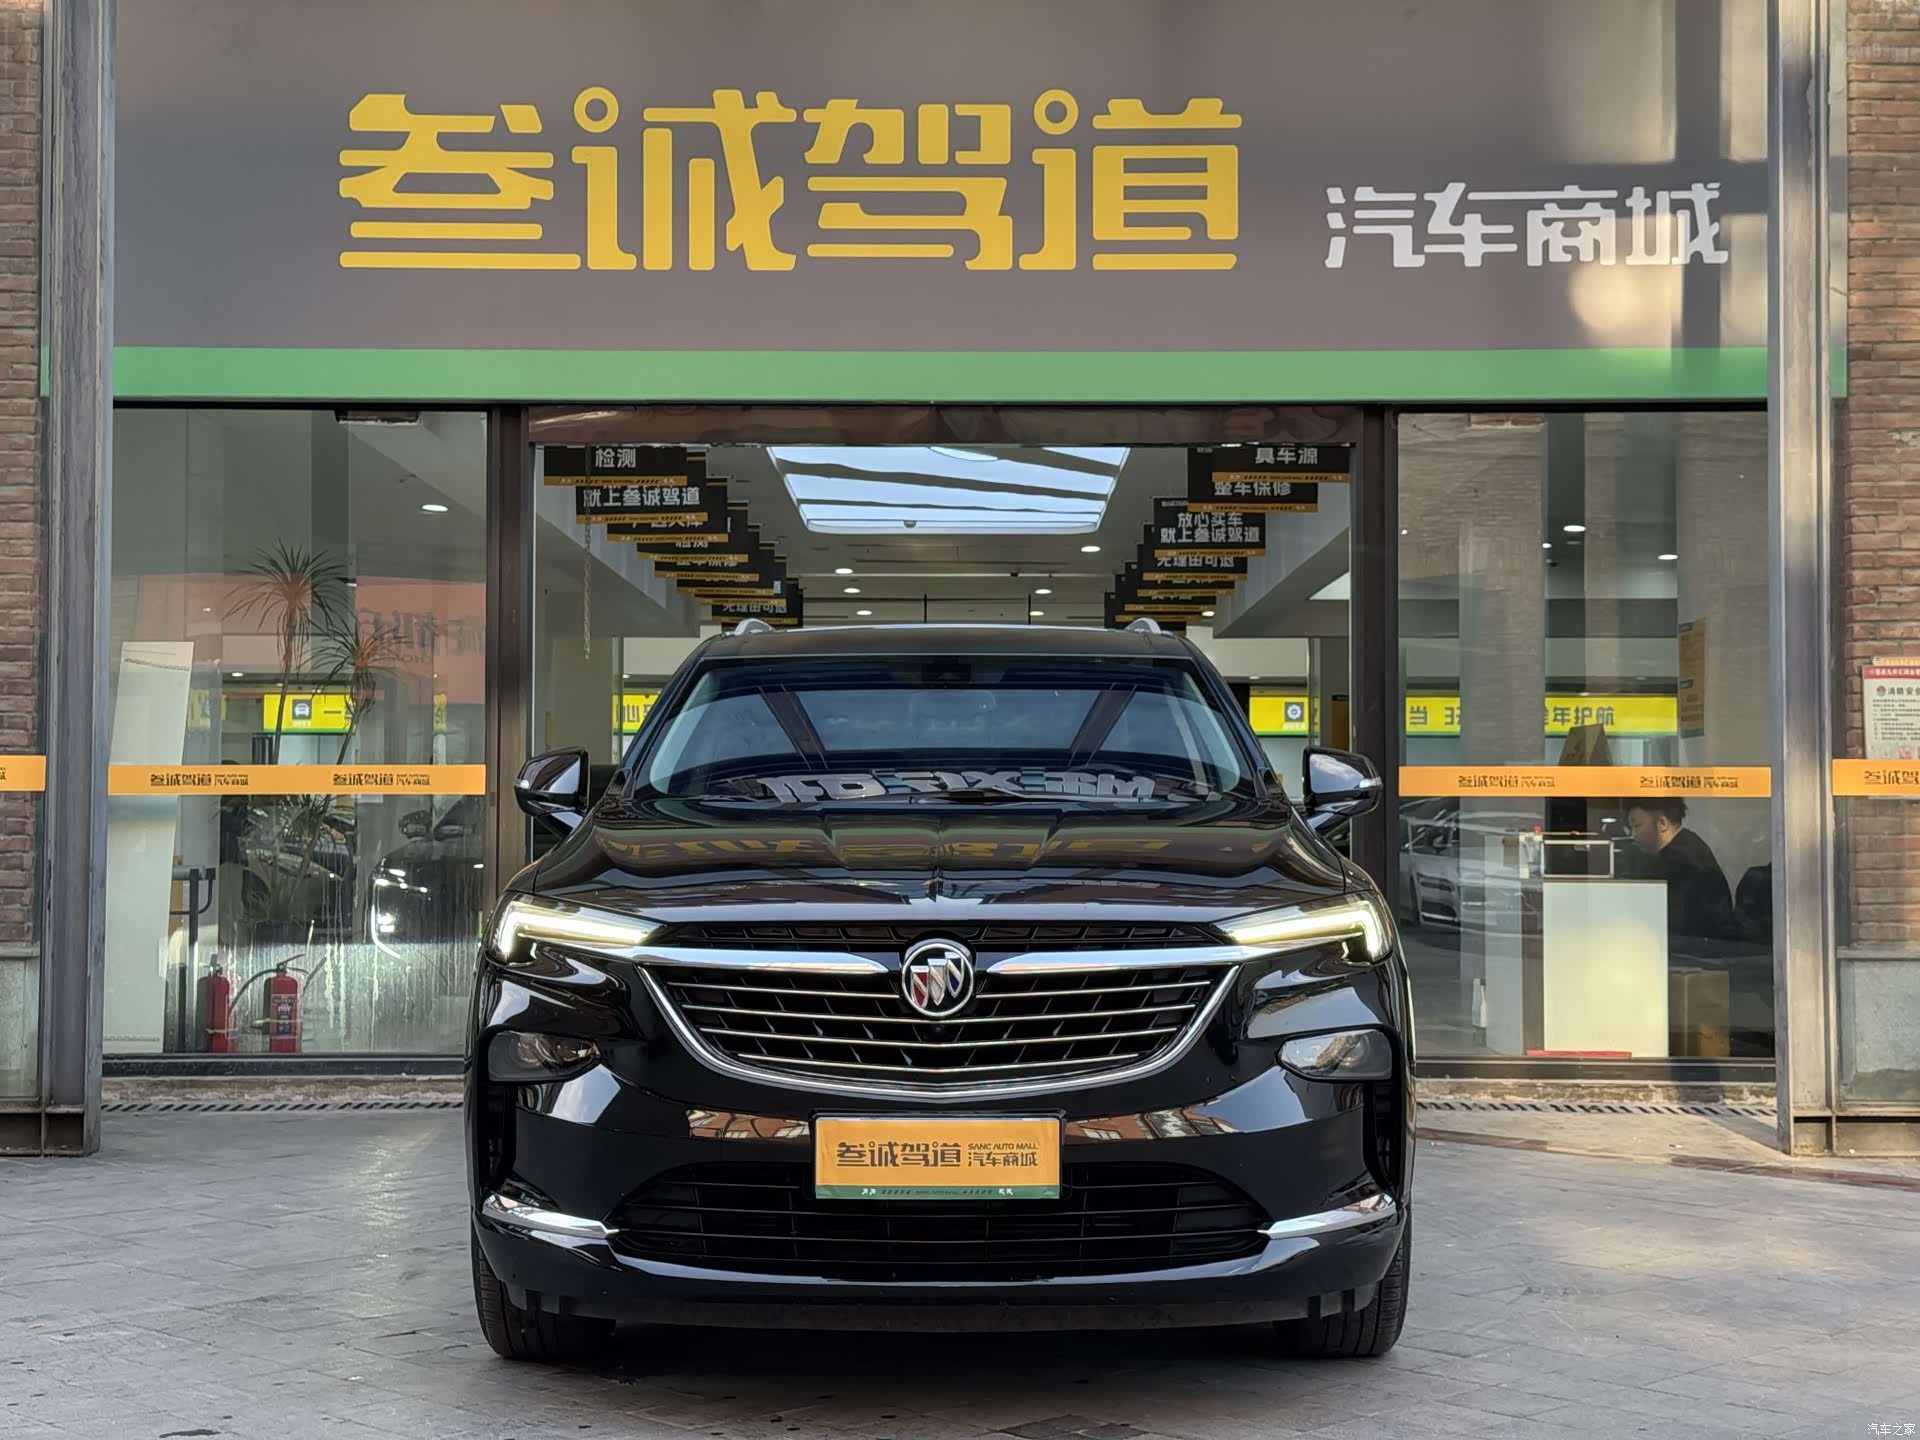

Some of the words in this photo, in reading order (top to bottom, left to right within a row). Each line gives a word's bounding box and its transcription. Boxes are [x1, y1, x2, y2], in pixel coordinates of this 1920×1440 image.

[339, 87, 1242, 271] 叁诚驾道
[1324, 182, 1728, 268] 汽车商城
[595, 448, 636, 468] 检测
[1177, 512, 1244, 527] 放心买车
[1160, 527, 1260, 543] 就上叁诚驾道
[837, 1141, 961, 1167] 叁诚驾道
[968, 1151, 1038, 1167] 汽车商城
